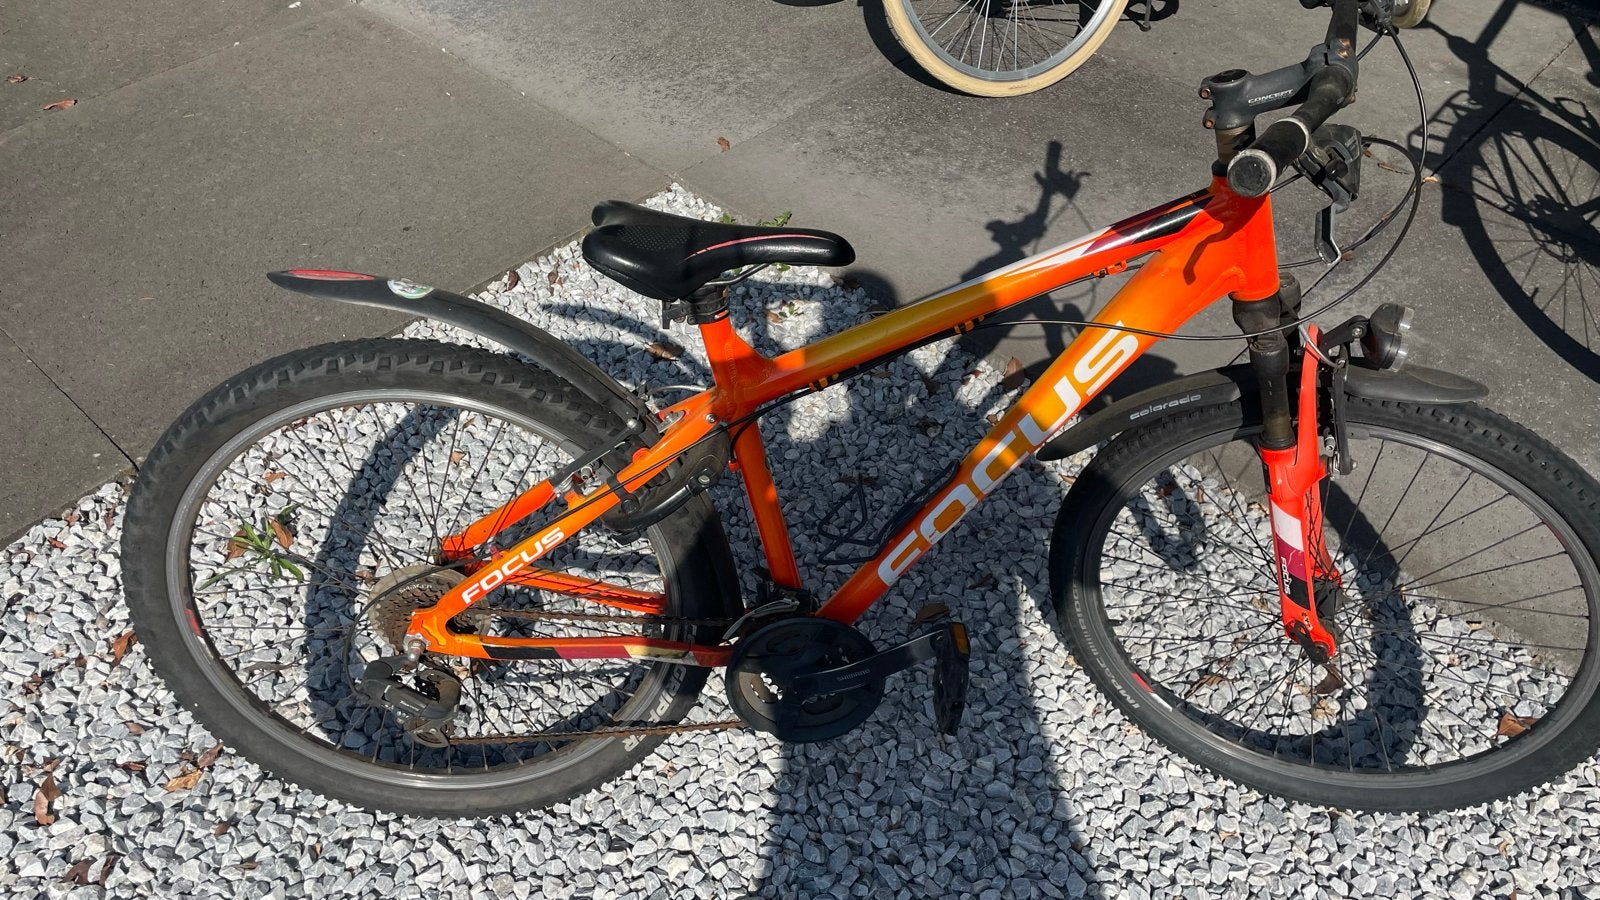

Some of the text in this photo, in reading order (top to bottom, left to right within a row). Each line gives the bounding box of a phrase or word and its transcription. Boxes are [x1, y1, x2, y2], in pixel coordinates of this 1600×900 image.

[1129, 394, 1202, 420] colorado
[878, 320, 1139, 587] FOCUS
[461, 526, 565, 605] FOCUS
[1280, 556, 1293, 596] FOCUS
